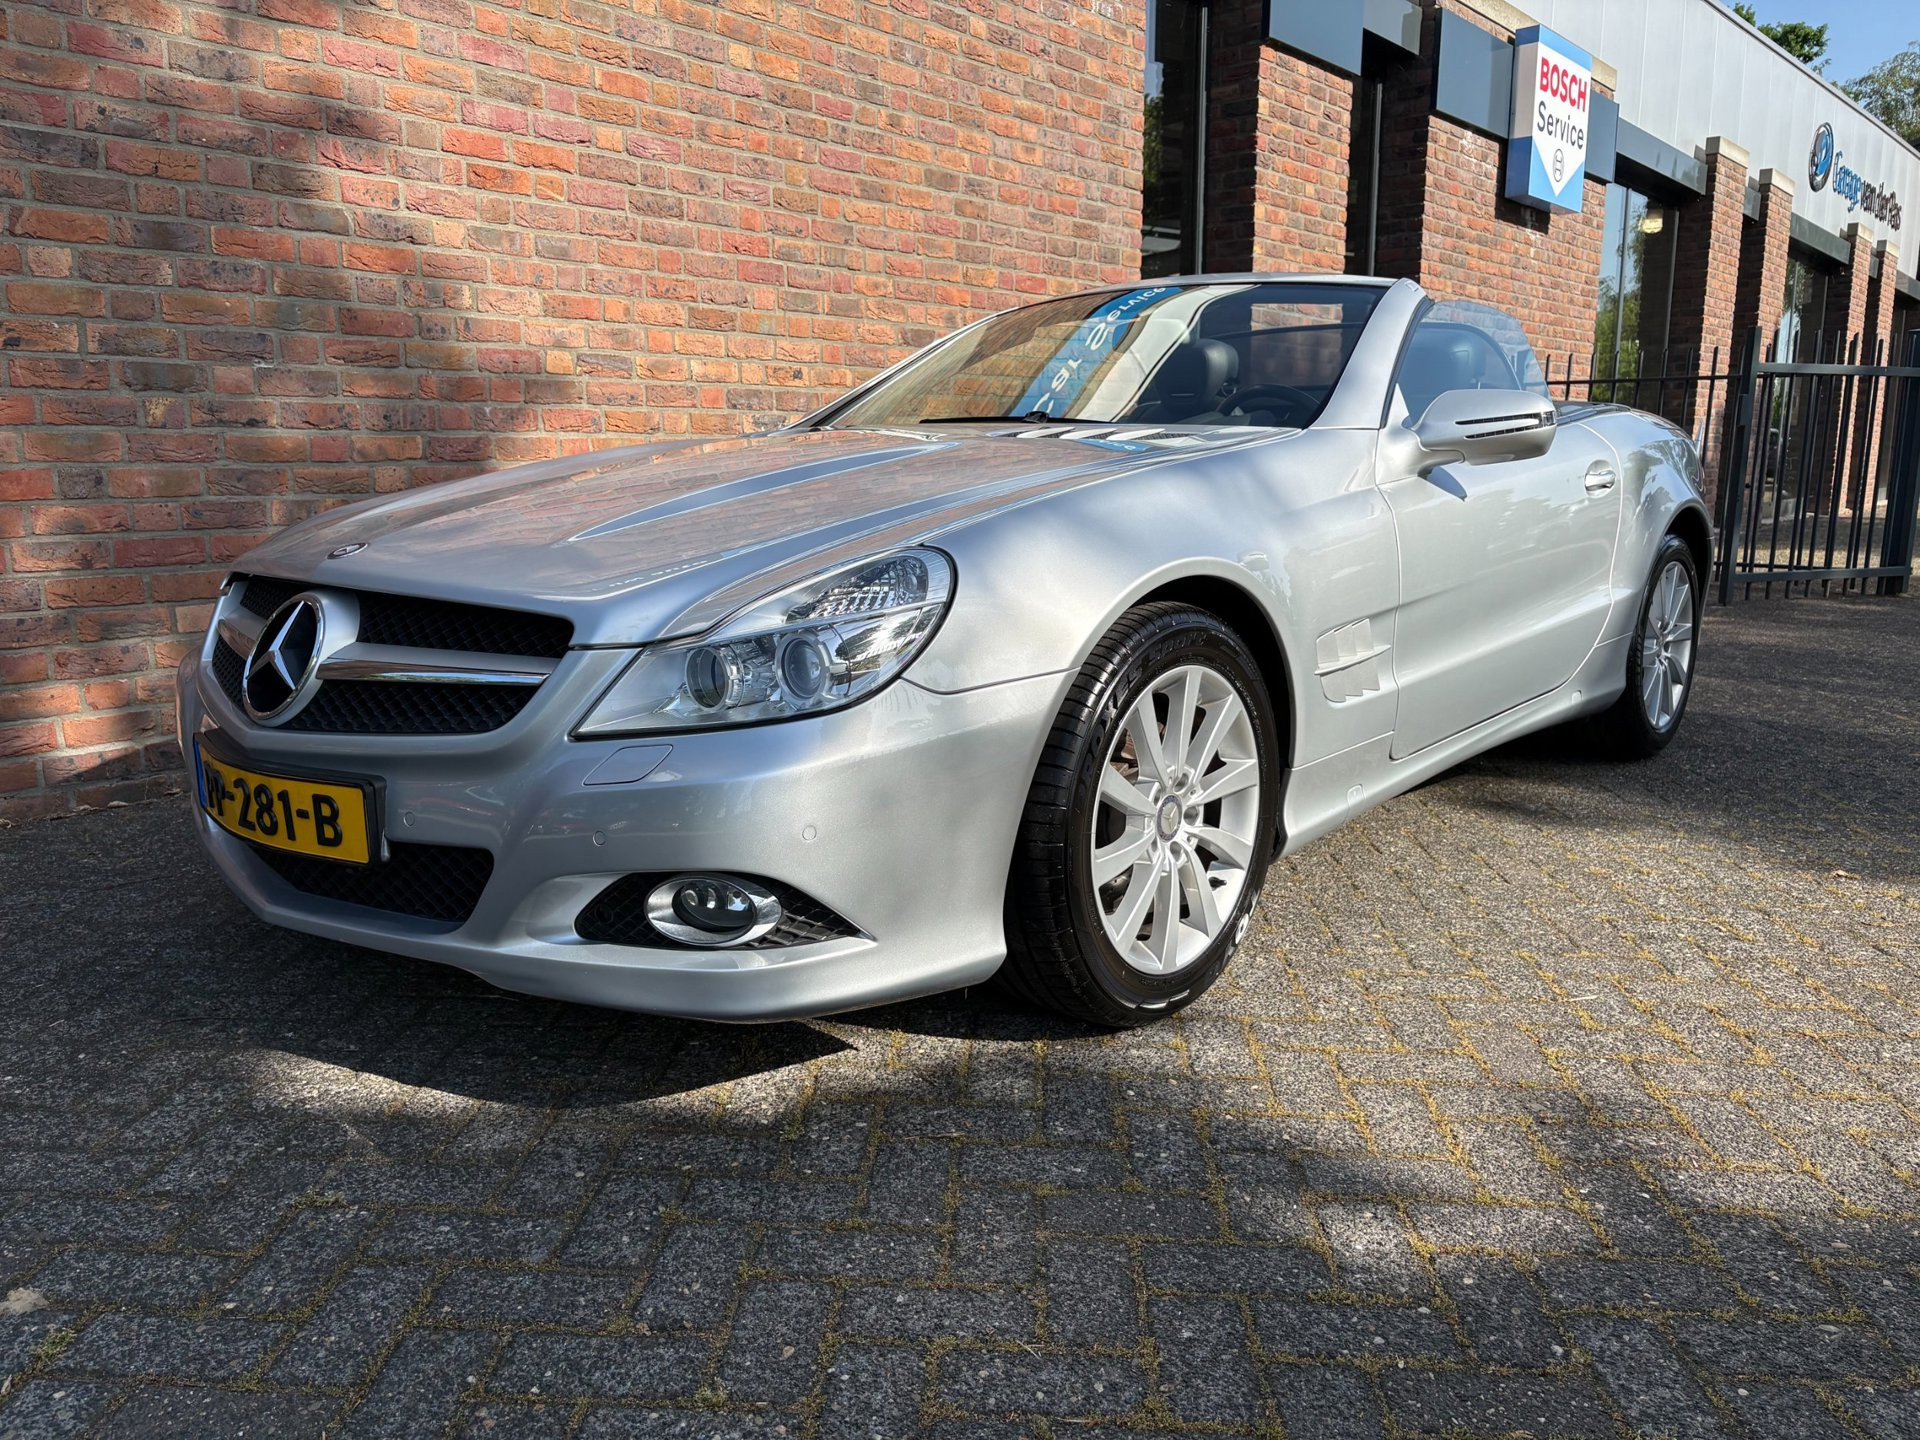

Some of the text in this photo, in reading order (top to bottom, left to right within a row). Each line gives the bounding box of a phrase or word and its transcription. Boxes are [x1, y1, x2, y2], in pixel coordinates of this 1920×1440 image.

[1540, 57, 1587, 112] BOSCH
[1537, 100, 1585, 150] Service
[1833, 151, 1861, 213] Garage
